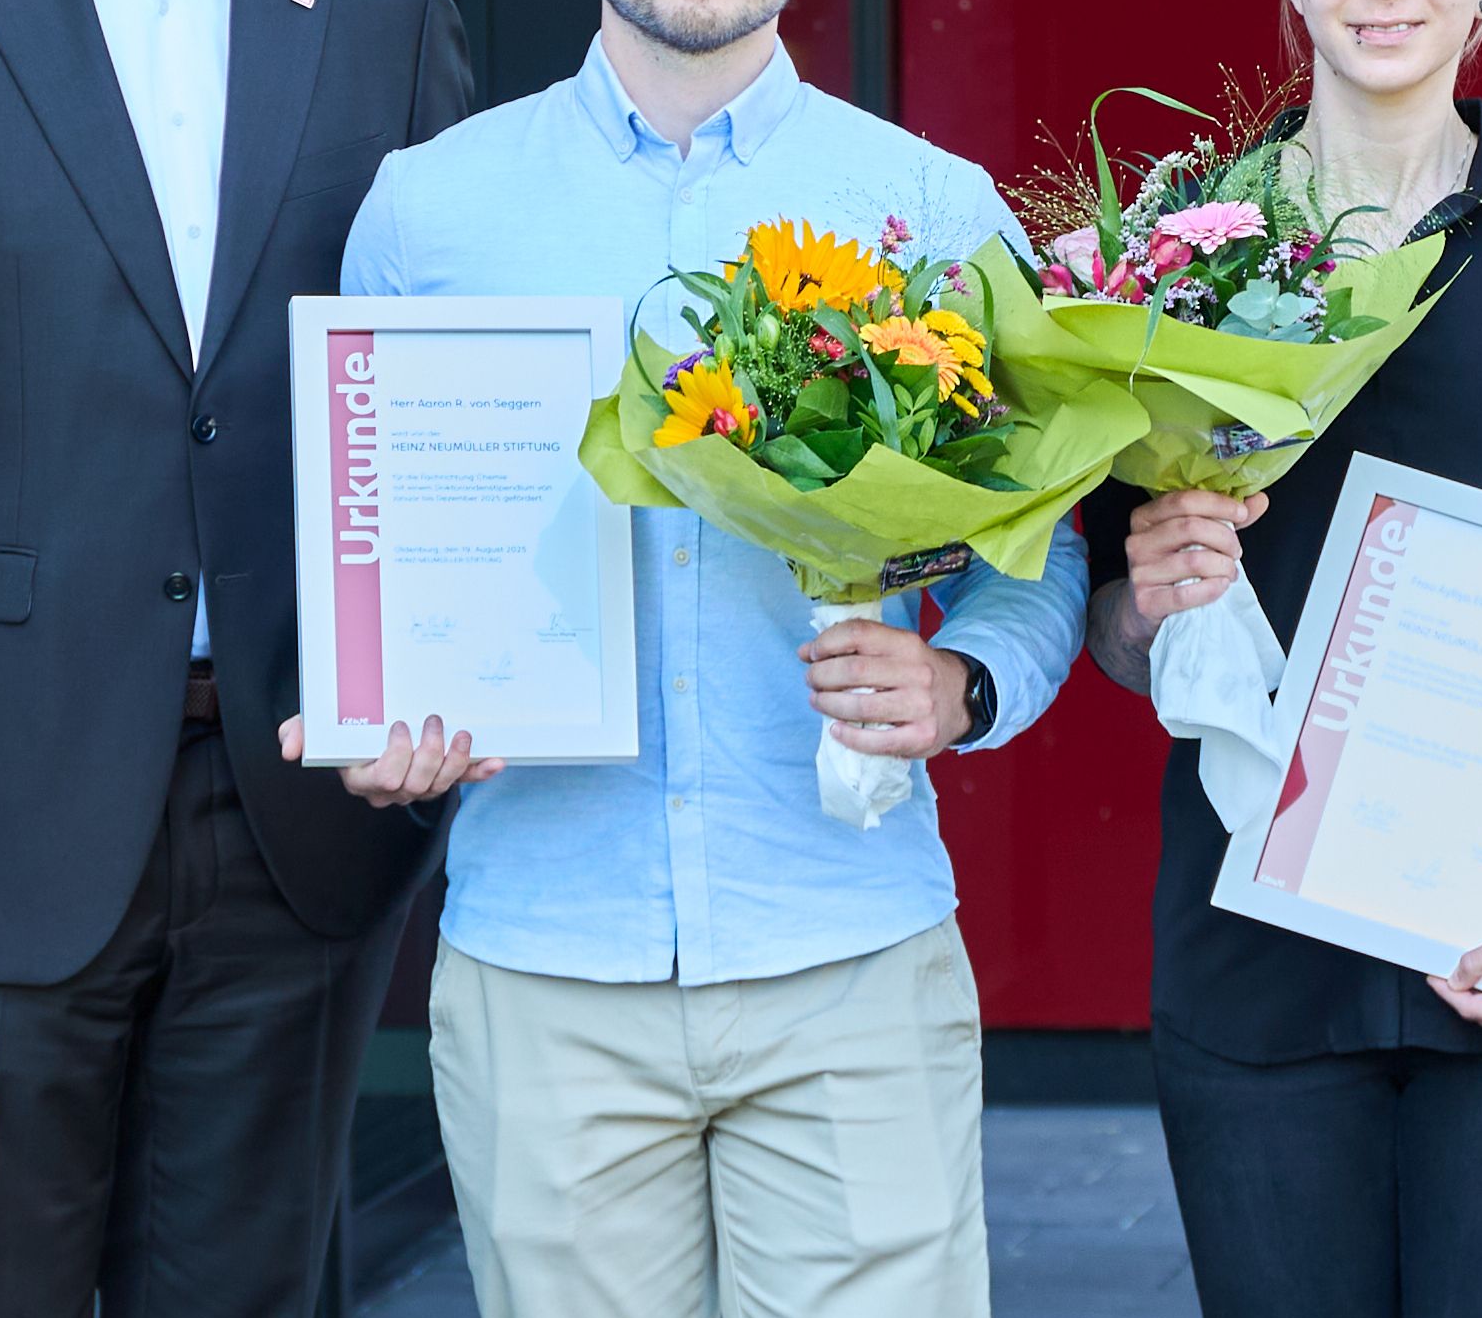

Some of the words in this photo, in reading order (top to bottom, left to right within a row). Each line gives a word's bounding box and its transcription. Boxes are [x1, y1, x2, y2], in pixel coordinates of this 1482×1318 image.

[335, 351, 379, 564] Urkunde
[390, 398, 414, 409] Herr
[418, 398, 452, 409] Aaron
[470, 400, 491, 409] von
[493, 398, 542, 411] Seggern
[391, 442, 425, 452] HEINZ
[429, 440, 500, 452] NEUMÜLLER
[503, 441, 561, 452] STIFTUNG
[1312, 519, 1413, 732] Urkunde
